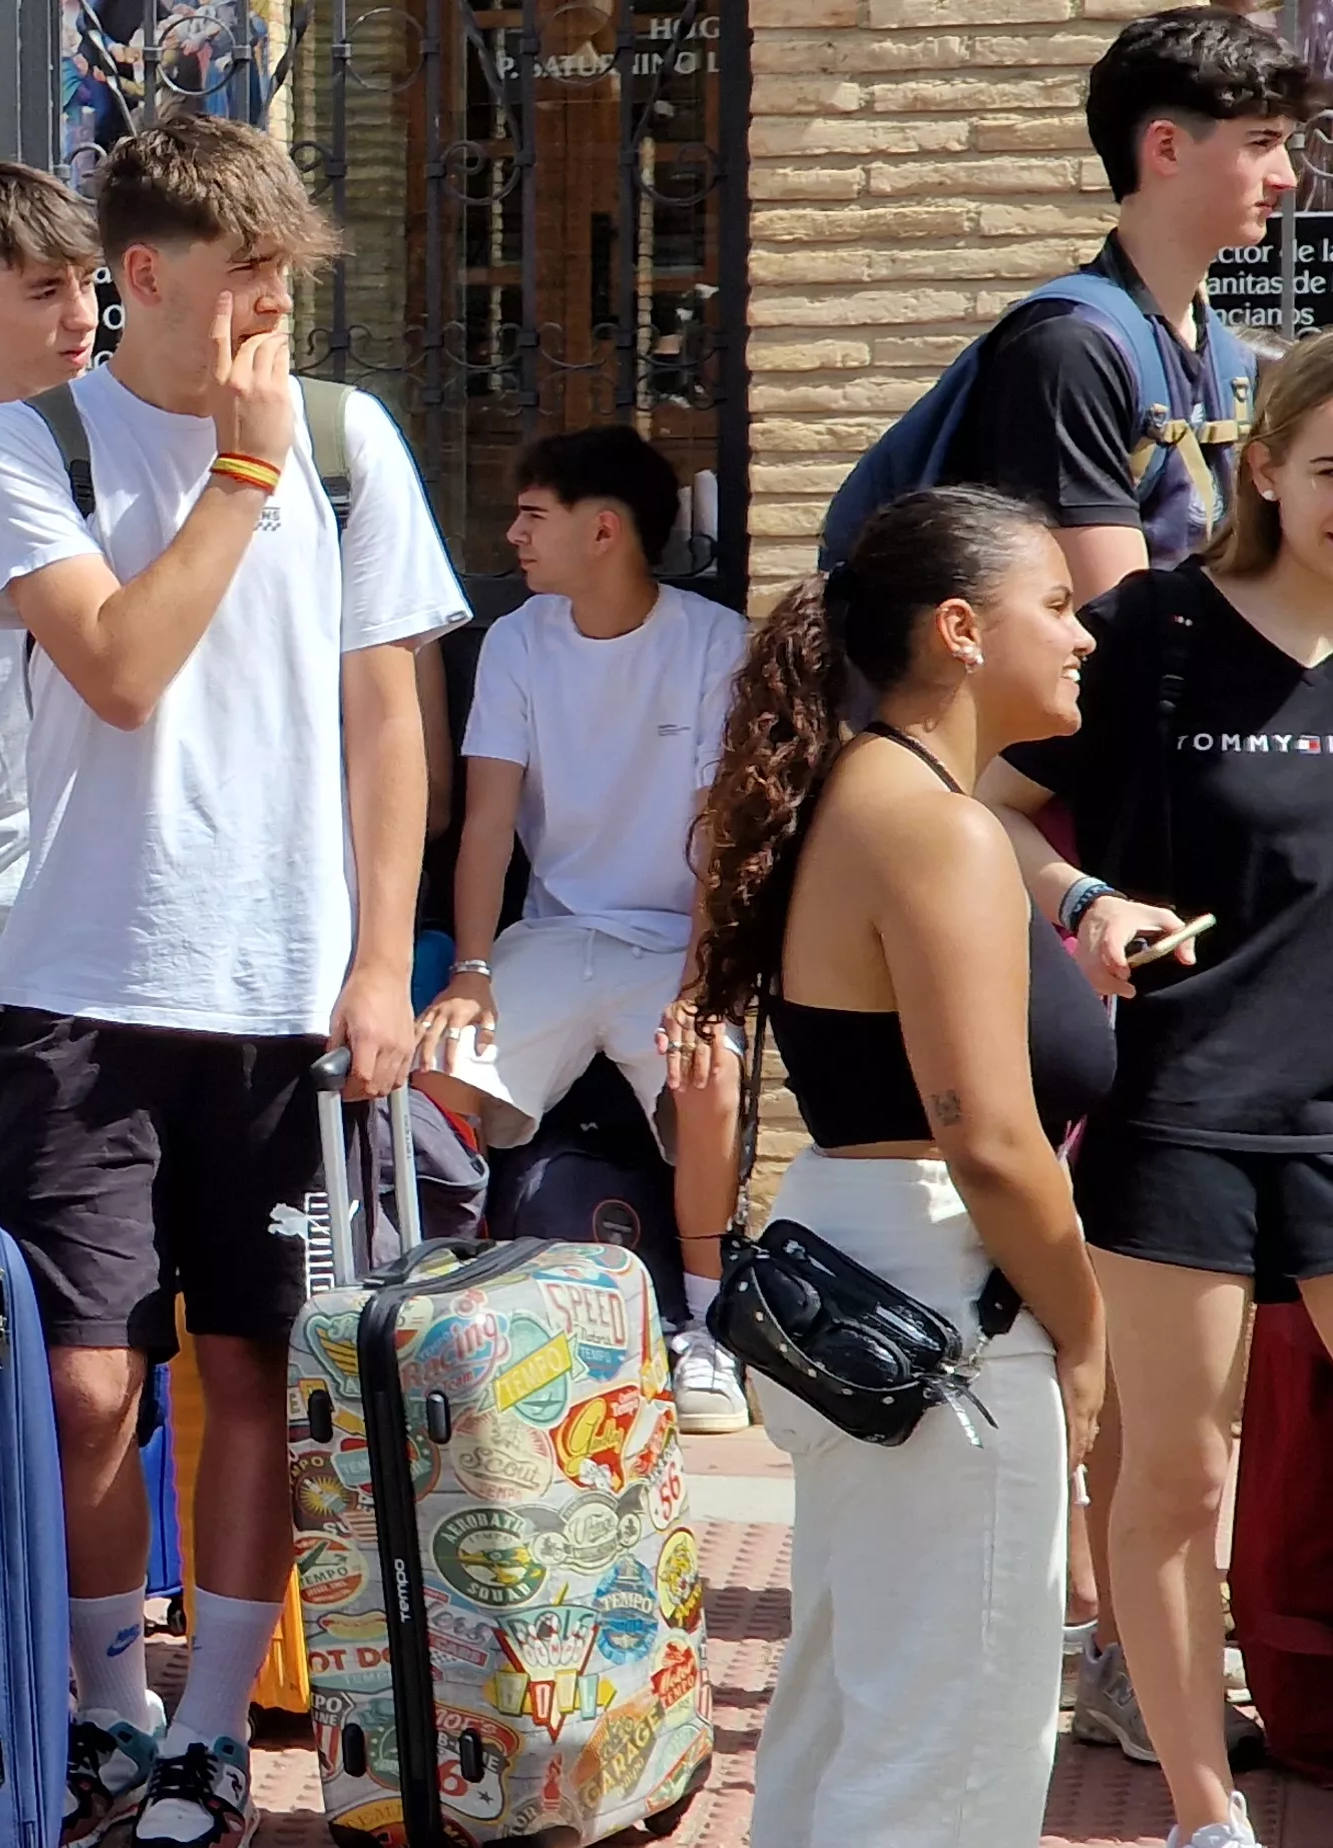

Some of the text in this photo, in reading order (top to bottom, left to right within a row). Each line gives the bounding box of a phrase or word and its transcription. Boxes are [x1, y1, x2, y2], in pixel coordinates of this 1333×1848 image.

[1210, 243, 1274, 265] ctor
[1176, 732, 1293, 753] TOMMY
[544, 1283, 627, 1346] SPEED
[399, 1312, 510, 1394] Racing
[501, 1347, 564, 1401] TEMPO
[659, 1461, 682, 1522] 56
[466, 1582, 531, 1603] SQUAD
[604, 1590, 653, 1614] TEMPO
[309, 1649, 347, 1673] OT
[582, 1706, 662, 1807] GARAGE
